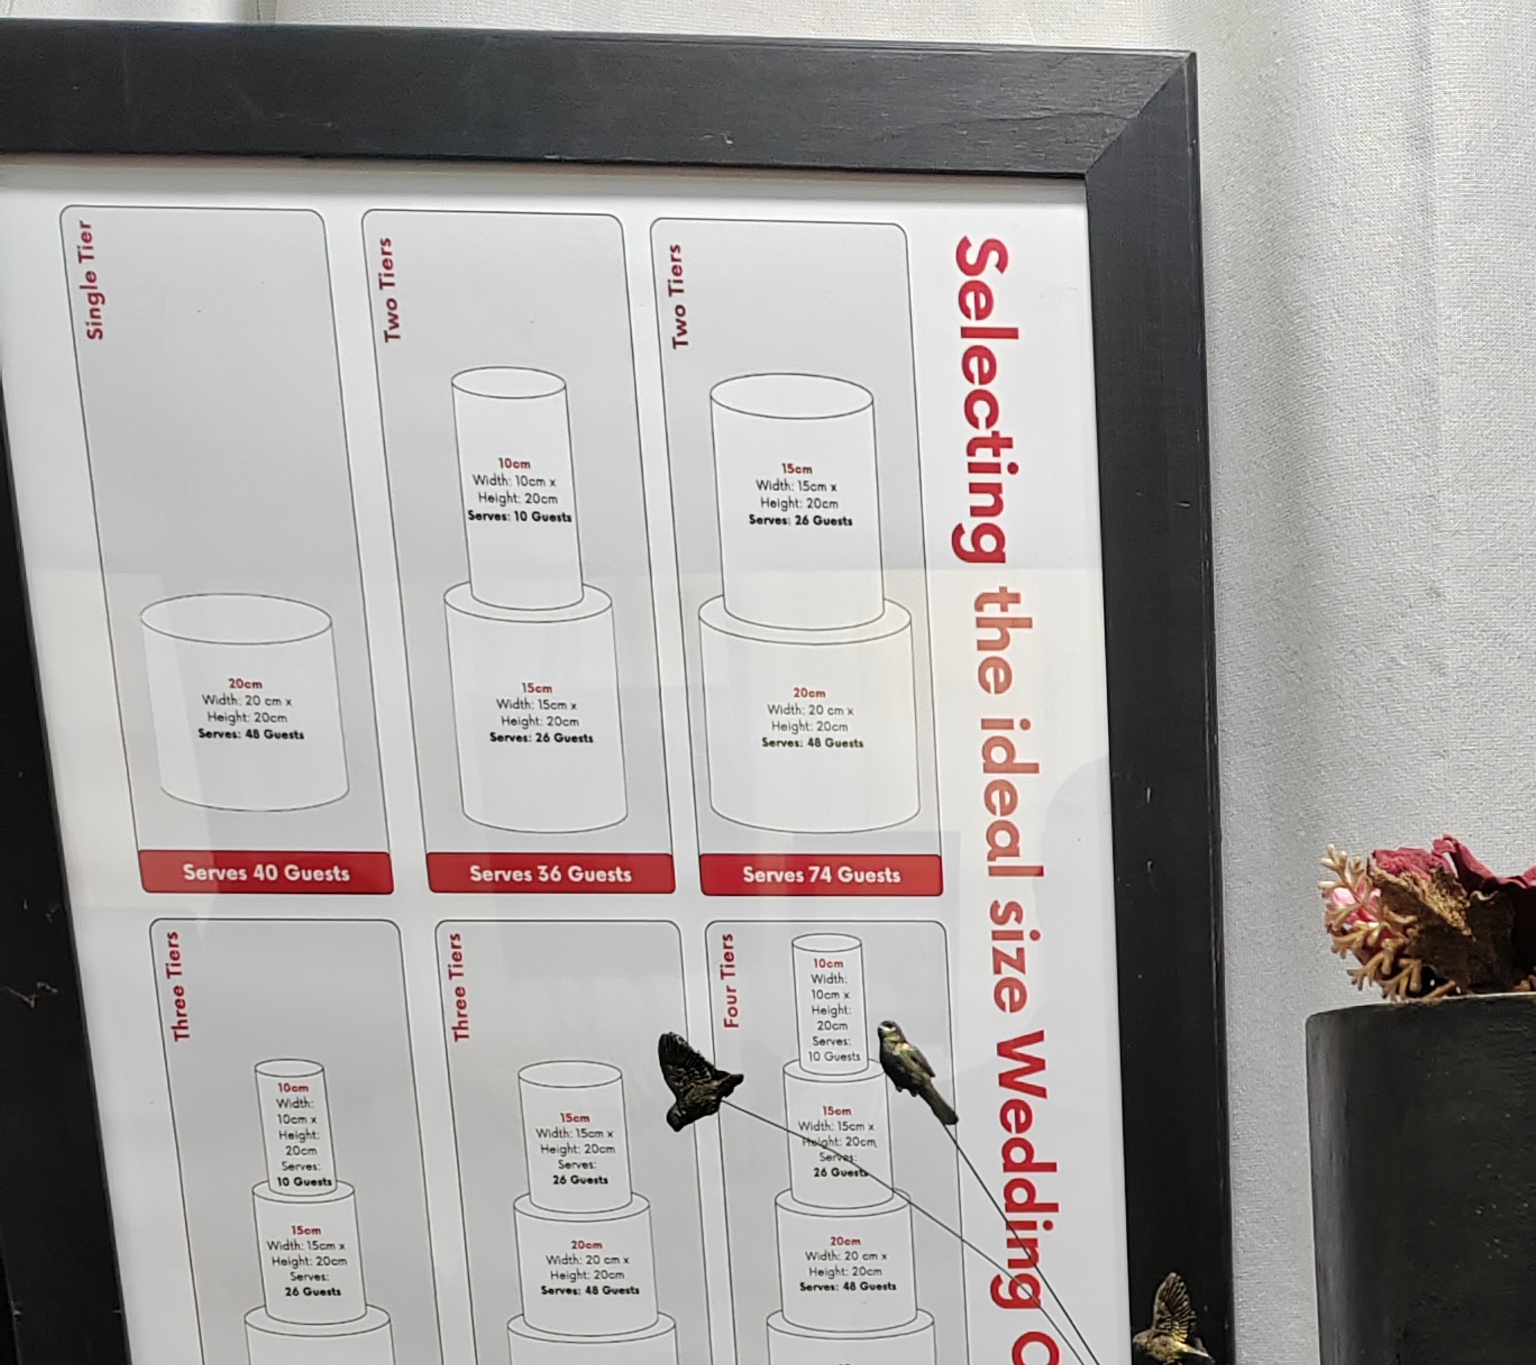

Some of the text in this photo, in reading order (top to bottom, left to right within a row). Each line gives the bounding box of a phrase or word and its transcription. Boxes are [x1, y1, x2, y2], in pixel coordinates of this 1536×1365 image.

[77, 220, 105, 341] Single Tier
[378, 237, 401, 343] Two Tiers
[668, 244, 689, 350] Two Tiers
[951, 235, 1020, 565] Selecting
[497, 457, 532, 470] 10cm
[781, 462, 813, 475] 15cm
[471, 472, 547, 487] Width: 10cm
[755, 477, 828, 493] Width: 15cm
[477, 490, 559, 508] Height: 20cm
[760, 495, 839, 513] Height: 20cm
[467, 510, 573, 524] Serves: 10 Guests
[748, 513, 854, 527] Serves: 26 Guests
[974, 586, 1033, 696] the
[228, 677, 263, 690] 20cm
[521, 682, 553, 694] 15cm
[201, 692, 262, 707] Width: 20
[793, 686, 827, 699] 20cm
[495, 696, 568, 711] Width: 15cm
[766, 702, 825, 716] Width: 20
[206, 709, 288, 727] Height: 20cm
[500, 713, 580, 731] Height: 20cm
[197, 727, 305, 740] Serves: 48 Guests
[771, 718, 849, 736] Height: 20cm
[489, 731, 594, 744] Serves: 26 Guests
[761, 736, 865, 749] Serves: 48 Guests
[981, 718, 1045, 878] ideal
[182, 863, 350, 882] Serves 40 Guests
[469, 864, 632, 883] Serves 36 Guests
[743, 865, 901, 884] Serves 74 Guests
[813, 957, 844, 969] 10cm
[989, 900, 1042, 1014] size
[719, 933, 739, 1028] Four Tiers
[810, 971, 848, 985] Width:
[165, 931, 190, 1042] Three Tiers
[447, 933, 469, 1043] Three Tiers
[810, 988, 841, 1000] 10cm
[811, 1002, 852, 1019] Height:
[816, 1019, 849, 1032] 20cm
[812, 1035, 851, 1047] Serves:
[808, 1050, 861, 1063] 10 Guests
[277, 1082, 310, 1093] 10cm
[275, 1095, 314, 1109] Width:
[822, 1105, 852, 1116] 15cm
[277, 1113, 308, 1125] 10cm
[559, 1112, 591, 1124] 15cm
[797, 1118, 866, 1132] Width: 15cm
[535, 1125, 605, 1139] Width: 15cm
[285, 1144, 318, 1157] 20cm
[813, 1166, 828, 1178] 26
[990, 1029, 1060, 1311] Wedding
[276, 1176, 333, 1188] 10 Guests
[552, 1174, 609, 1186] 26 Guests
[290, 1225, 322, 1236] 15cm
[266, 1238, 336, 1251] Width: 15cm
[570, 1239, 604, 1250] 20cm
[829, 1235, 862, 1247] 20cm
[284, 1286, 342, 1297] 26 Guests
[540, 1284, 641, 1296] Serves: 48 Guests
[799, 1280, 897, 1292] Serves: 48 Guests
